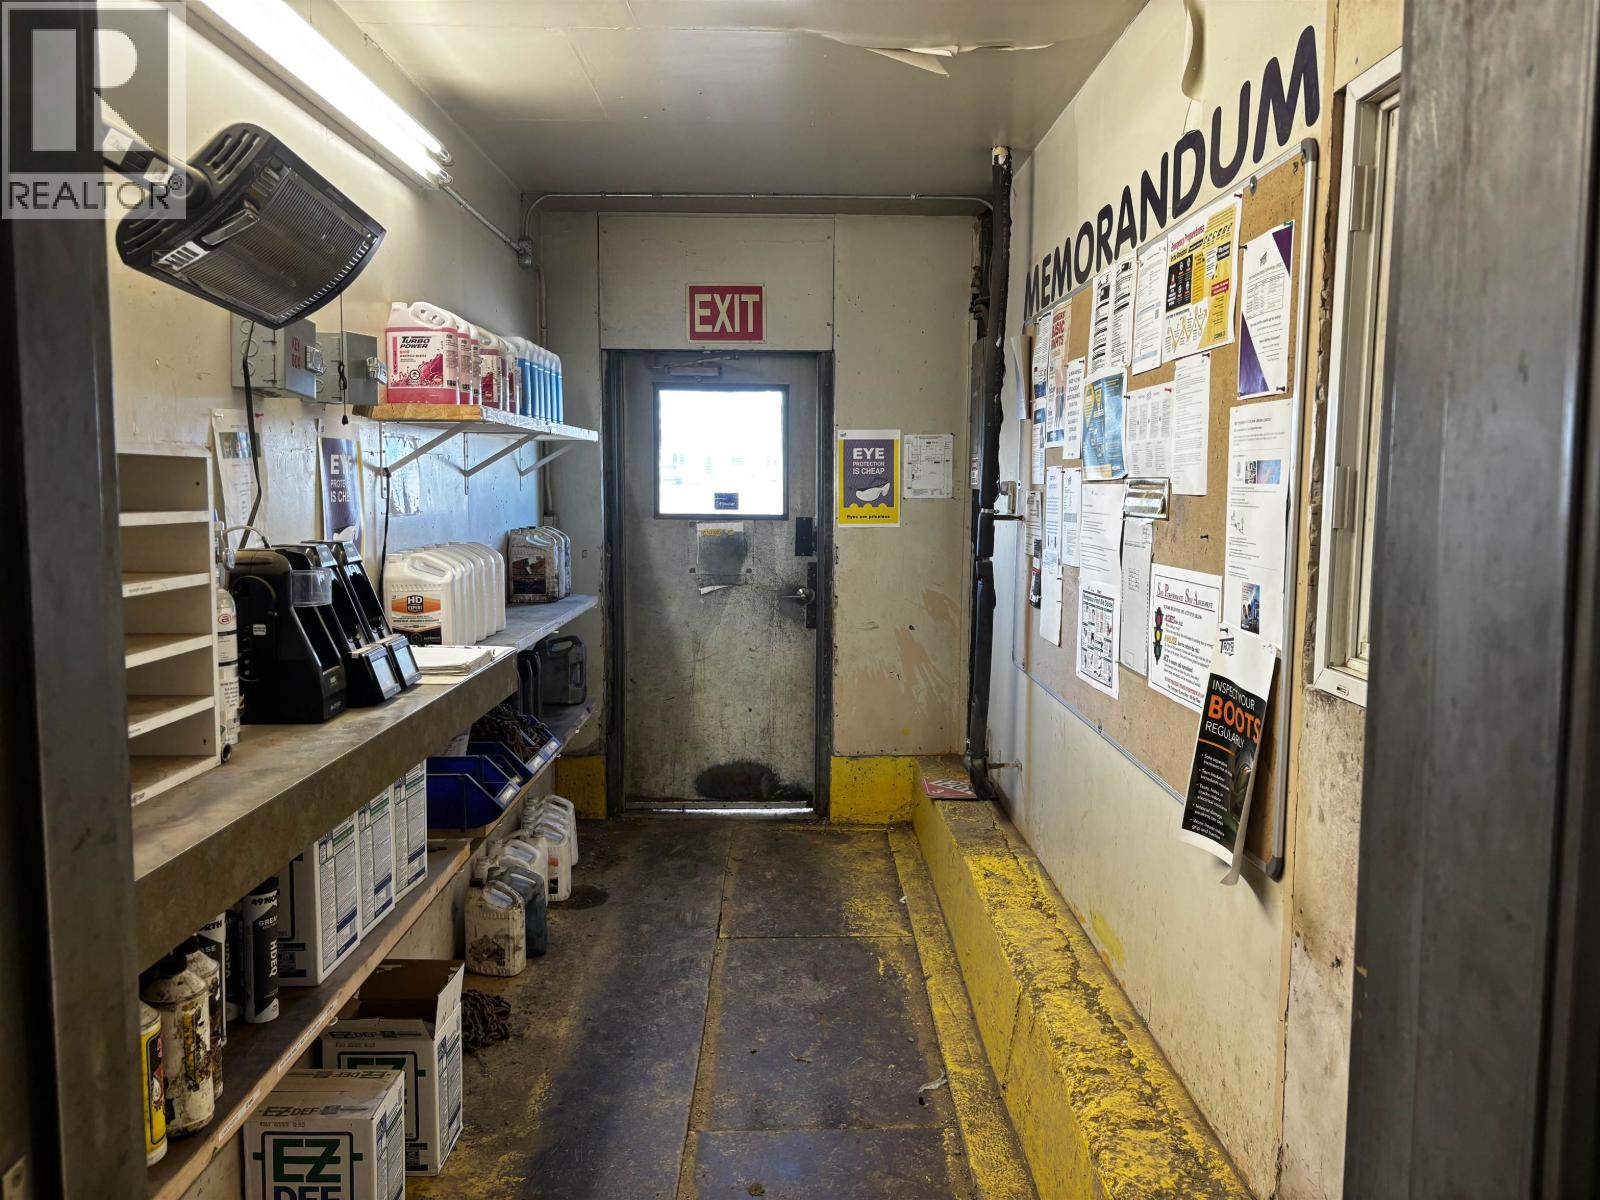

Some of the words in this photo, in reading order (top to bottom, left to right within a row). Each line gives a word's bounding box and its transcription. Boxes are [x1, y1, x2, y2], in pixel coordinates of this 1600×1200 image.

[1024, 25, 1320, 317] MEMORANDUM
[694, 293, 760, 333] EXIT
[401, 336, 430, 344] TURBO
[853, 448, 885, 460] EYE
[330, 492, 337, 502] IS
[1212, 680, 1240, 701] INSPECT
[1239, 693, 1255, 711] YOUR
[1208, 694, 1261, 744] BOOTS
[1205, 721, 1245, 749] REGULARLY
[251, 898, 263, 906] 49
[258, 915, 278, 927] GREA
[269, 938, 278, 978] HDEQ
[291, 1108, 320, 1116] DEF
[273, 1139, 341, 1182] EZ
